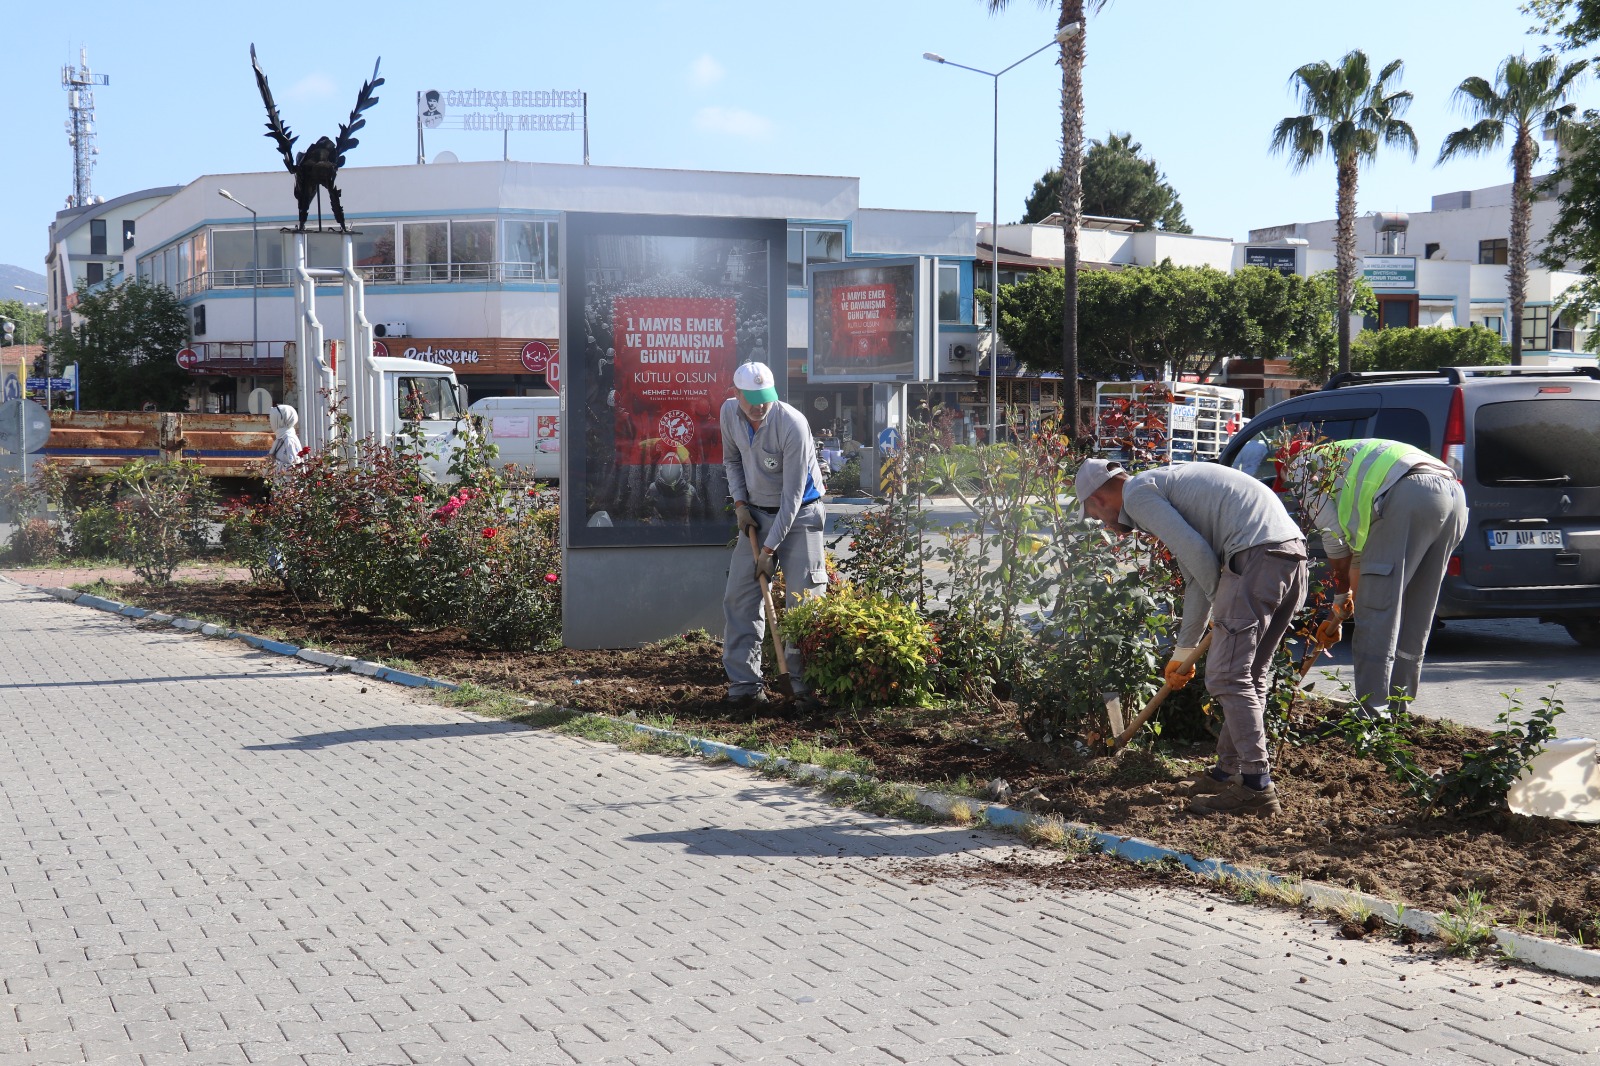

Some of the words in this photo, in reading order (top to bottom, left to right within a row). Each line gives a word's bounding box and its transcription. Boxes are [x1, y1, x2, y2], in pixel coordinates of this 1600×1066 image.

[446, 88, 509, 112] GAZİPAŞA
[512, 88, 582, 108] BELEDİYESİ
[463, 112, 514, 131] KÜLTÜR
[517, 112, 575, 131] MERKEZİ
[848, 291, 866, 300] MAYIS
[868, 290, 885, 298] EMEK
[841, 302, 848, 310] VE
[851, 300, 885, 310] DAYANIŞMA
[626, 317, 635, 332] 1
[639, 317, 682, 332] MAYIS
[686, 318, 723, 332] EMEK
[625, 333, 642, 348] VE
[646, 333, 725, 349] DAYANIŞMA
[403, 345, 479, 365] Patisserie
[640, 349, 711, 364] GÜNÜ'MÜZ
[634, 372, 671, 383] KUTLU
[675, 372, 717, 383] OLSUN
[671, 388, 682, 396] ALİ
[1173, 405, 1195, 417] AYGAZ
[1495, 531, 1509, 545] 07
[1516, 531, 1535, 545] AUA
[1540, 531, 1560, 545] 085
